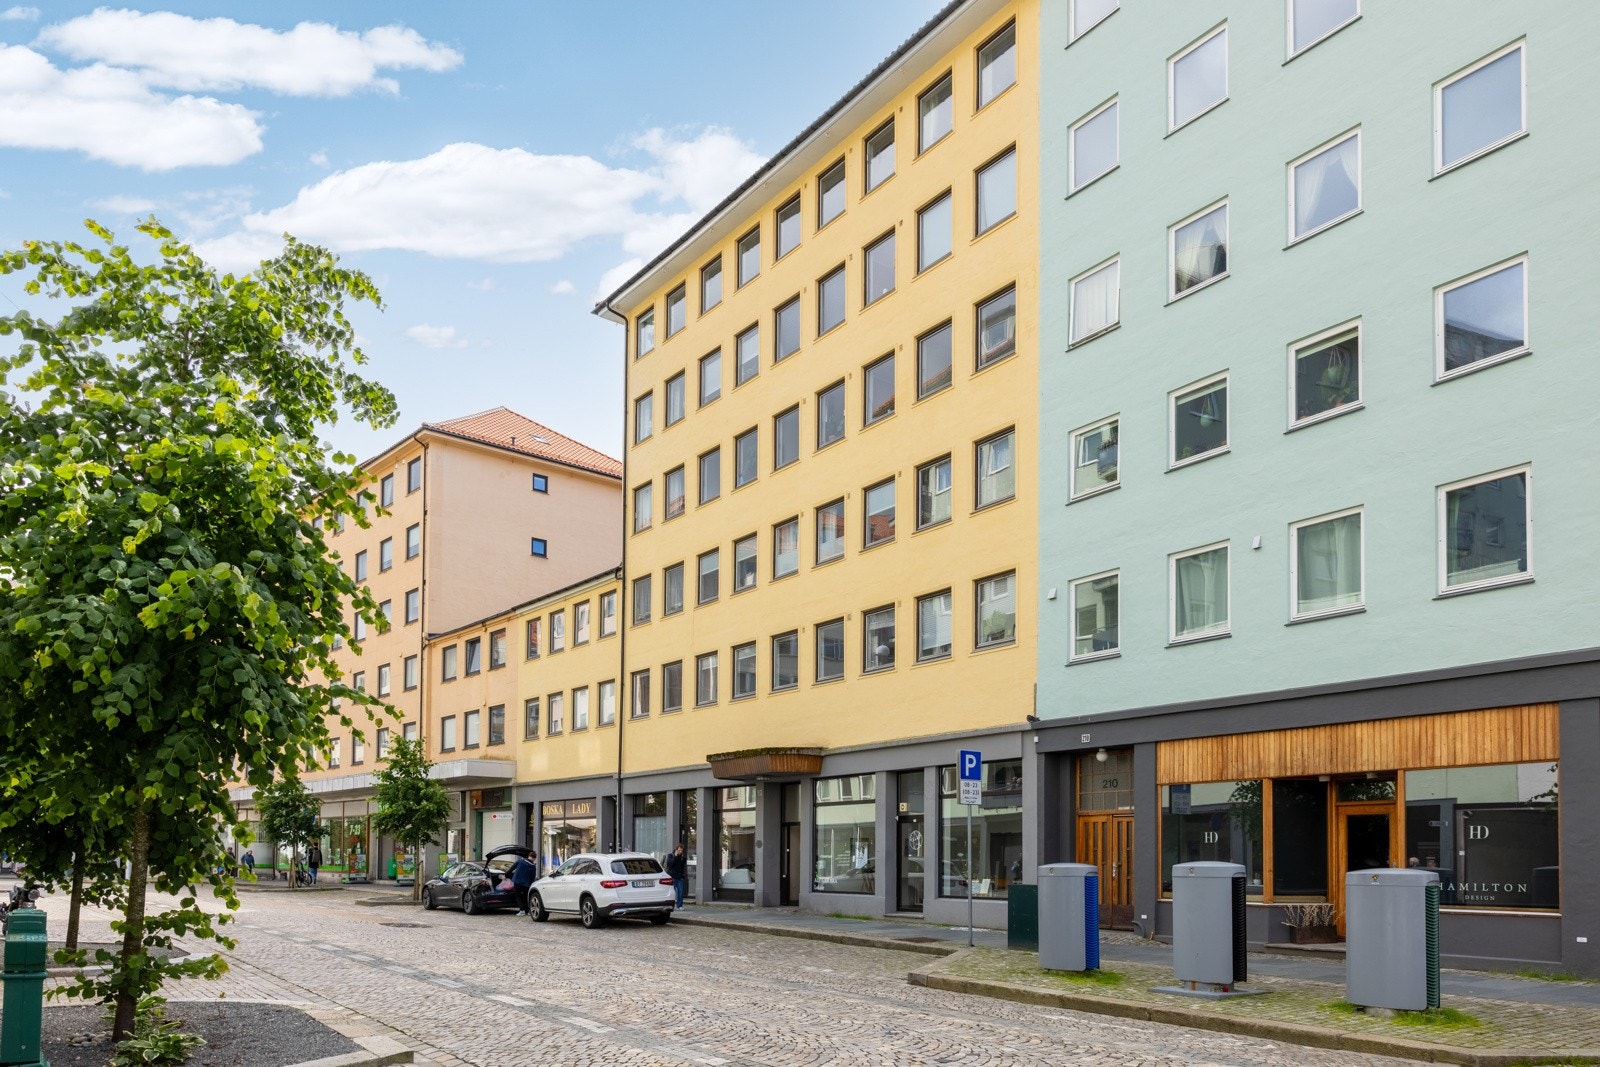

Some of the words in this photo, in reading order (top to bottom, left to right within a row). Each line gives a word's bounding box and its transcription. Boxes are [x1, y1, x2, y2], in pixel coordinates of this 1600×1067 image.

[965, 754, 977, 777] P
[1102, 779, 1119, 789] 210
[543, 804, 563, 816] BOSKA
[572, 803, 591, 814] LADY
[1204, 831, 1219, 843] HD
[1468, 825, 1490, 840] HD
